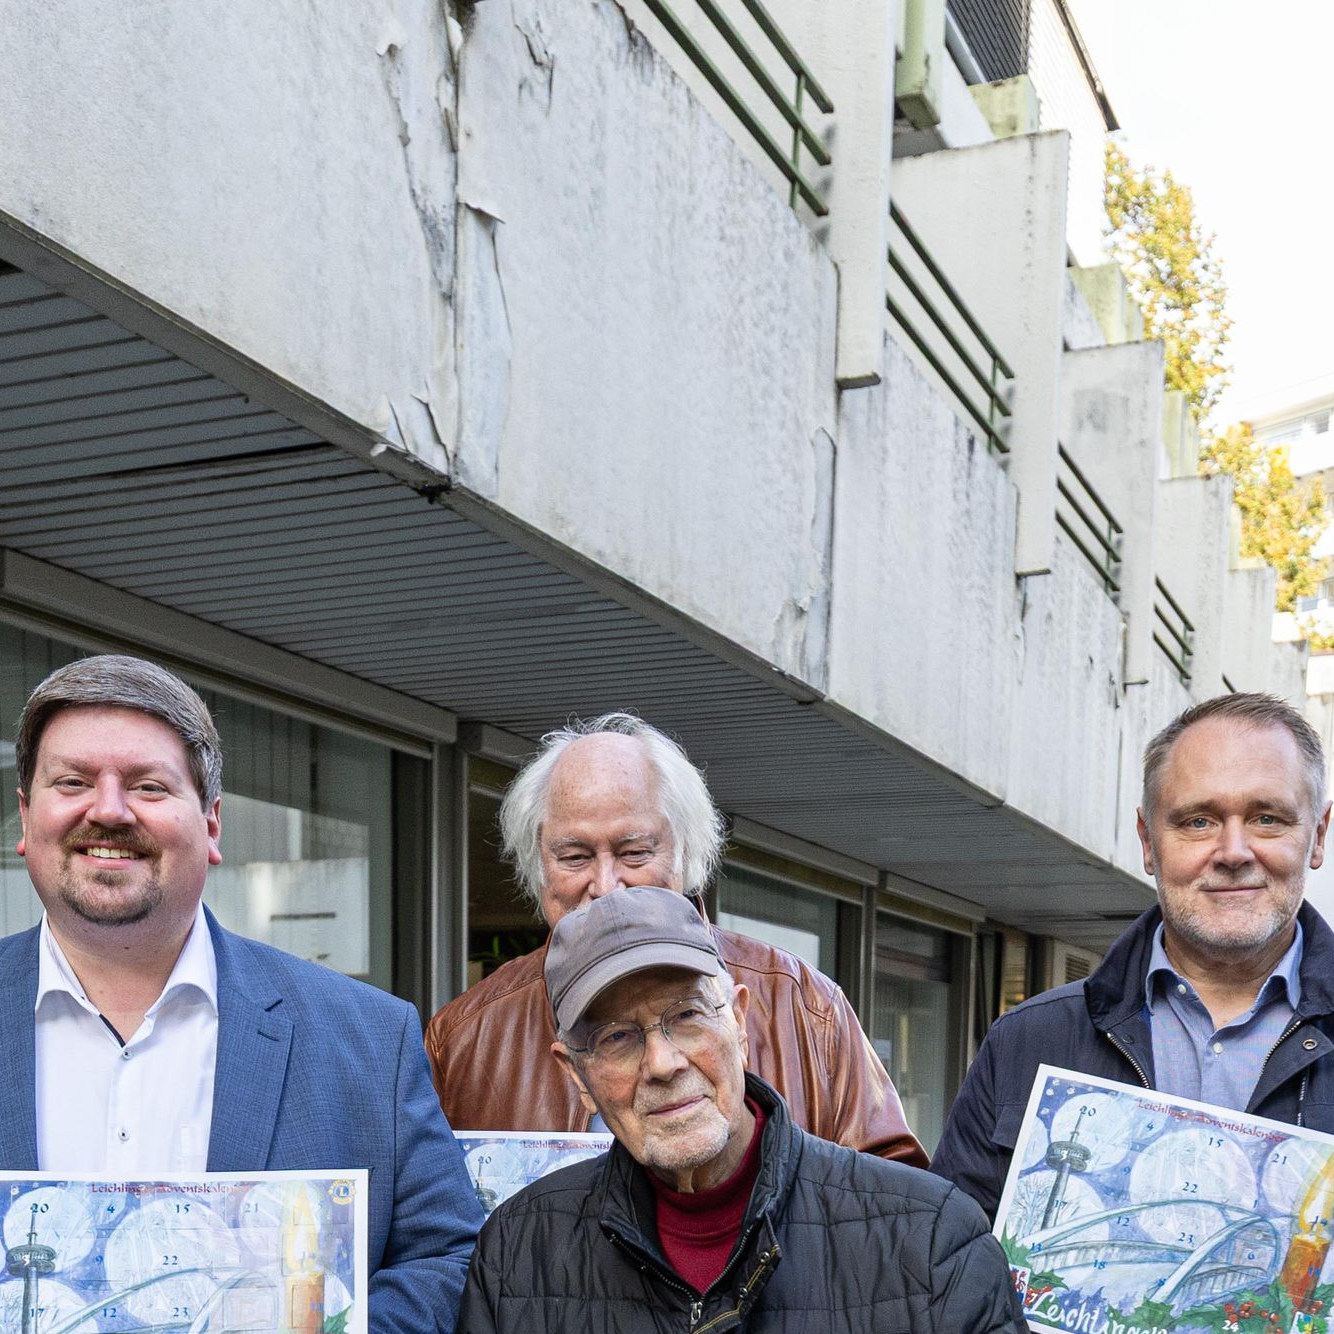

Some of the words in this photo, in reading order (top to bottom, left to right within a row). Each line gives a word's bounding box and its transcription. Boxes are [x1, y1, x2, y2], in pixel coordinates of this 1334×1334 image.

[1080, 1105, 1097, 1116] 20
[1137, 1098, 1193, 1121] Leichling
[1208, 1137, 1224, 1148] 15
[1272, 1153, 1287, 1164] 21
[91, 1183, 155, 1196] Leichling
[1183, 1182, 1198, 1193] 22
[31, 1203, 49, 1212] 20
[176, 1204, 190, 1213] 15
[1116, 1216, 1130, 1227] 12
[1313, 1216, 1329, 1227] 14
[1178, 1232, 1195, 1244] 23
[163, 1256, 178, 1265] 22
[1093, 1259, 1106, 1270] 18
[104, 1308, 117, 1318] 12
[173, 1307, 189, 1317] 23
[1222, 1320, 1240, 1332] 24
